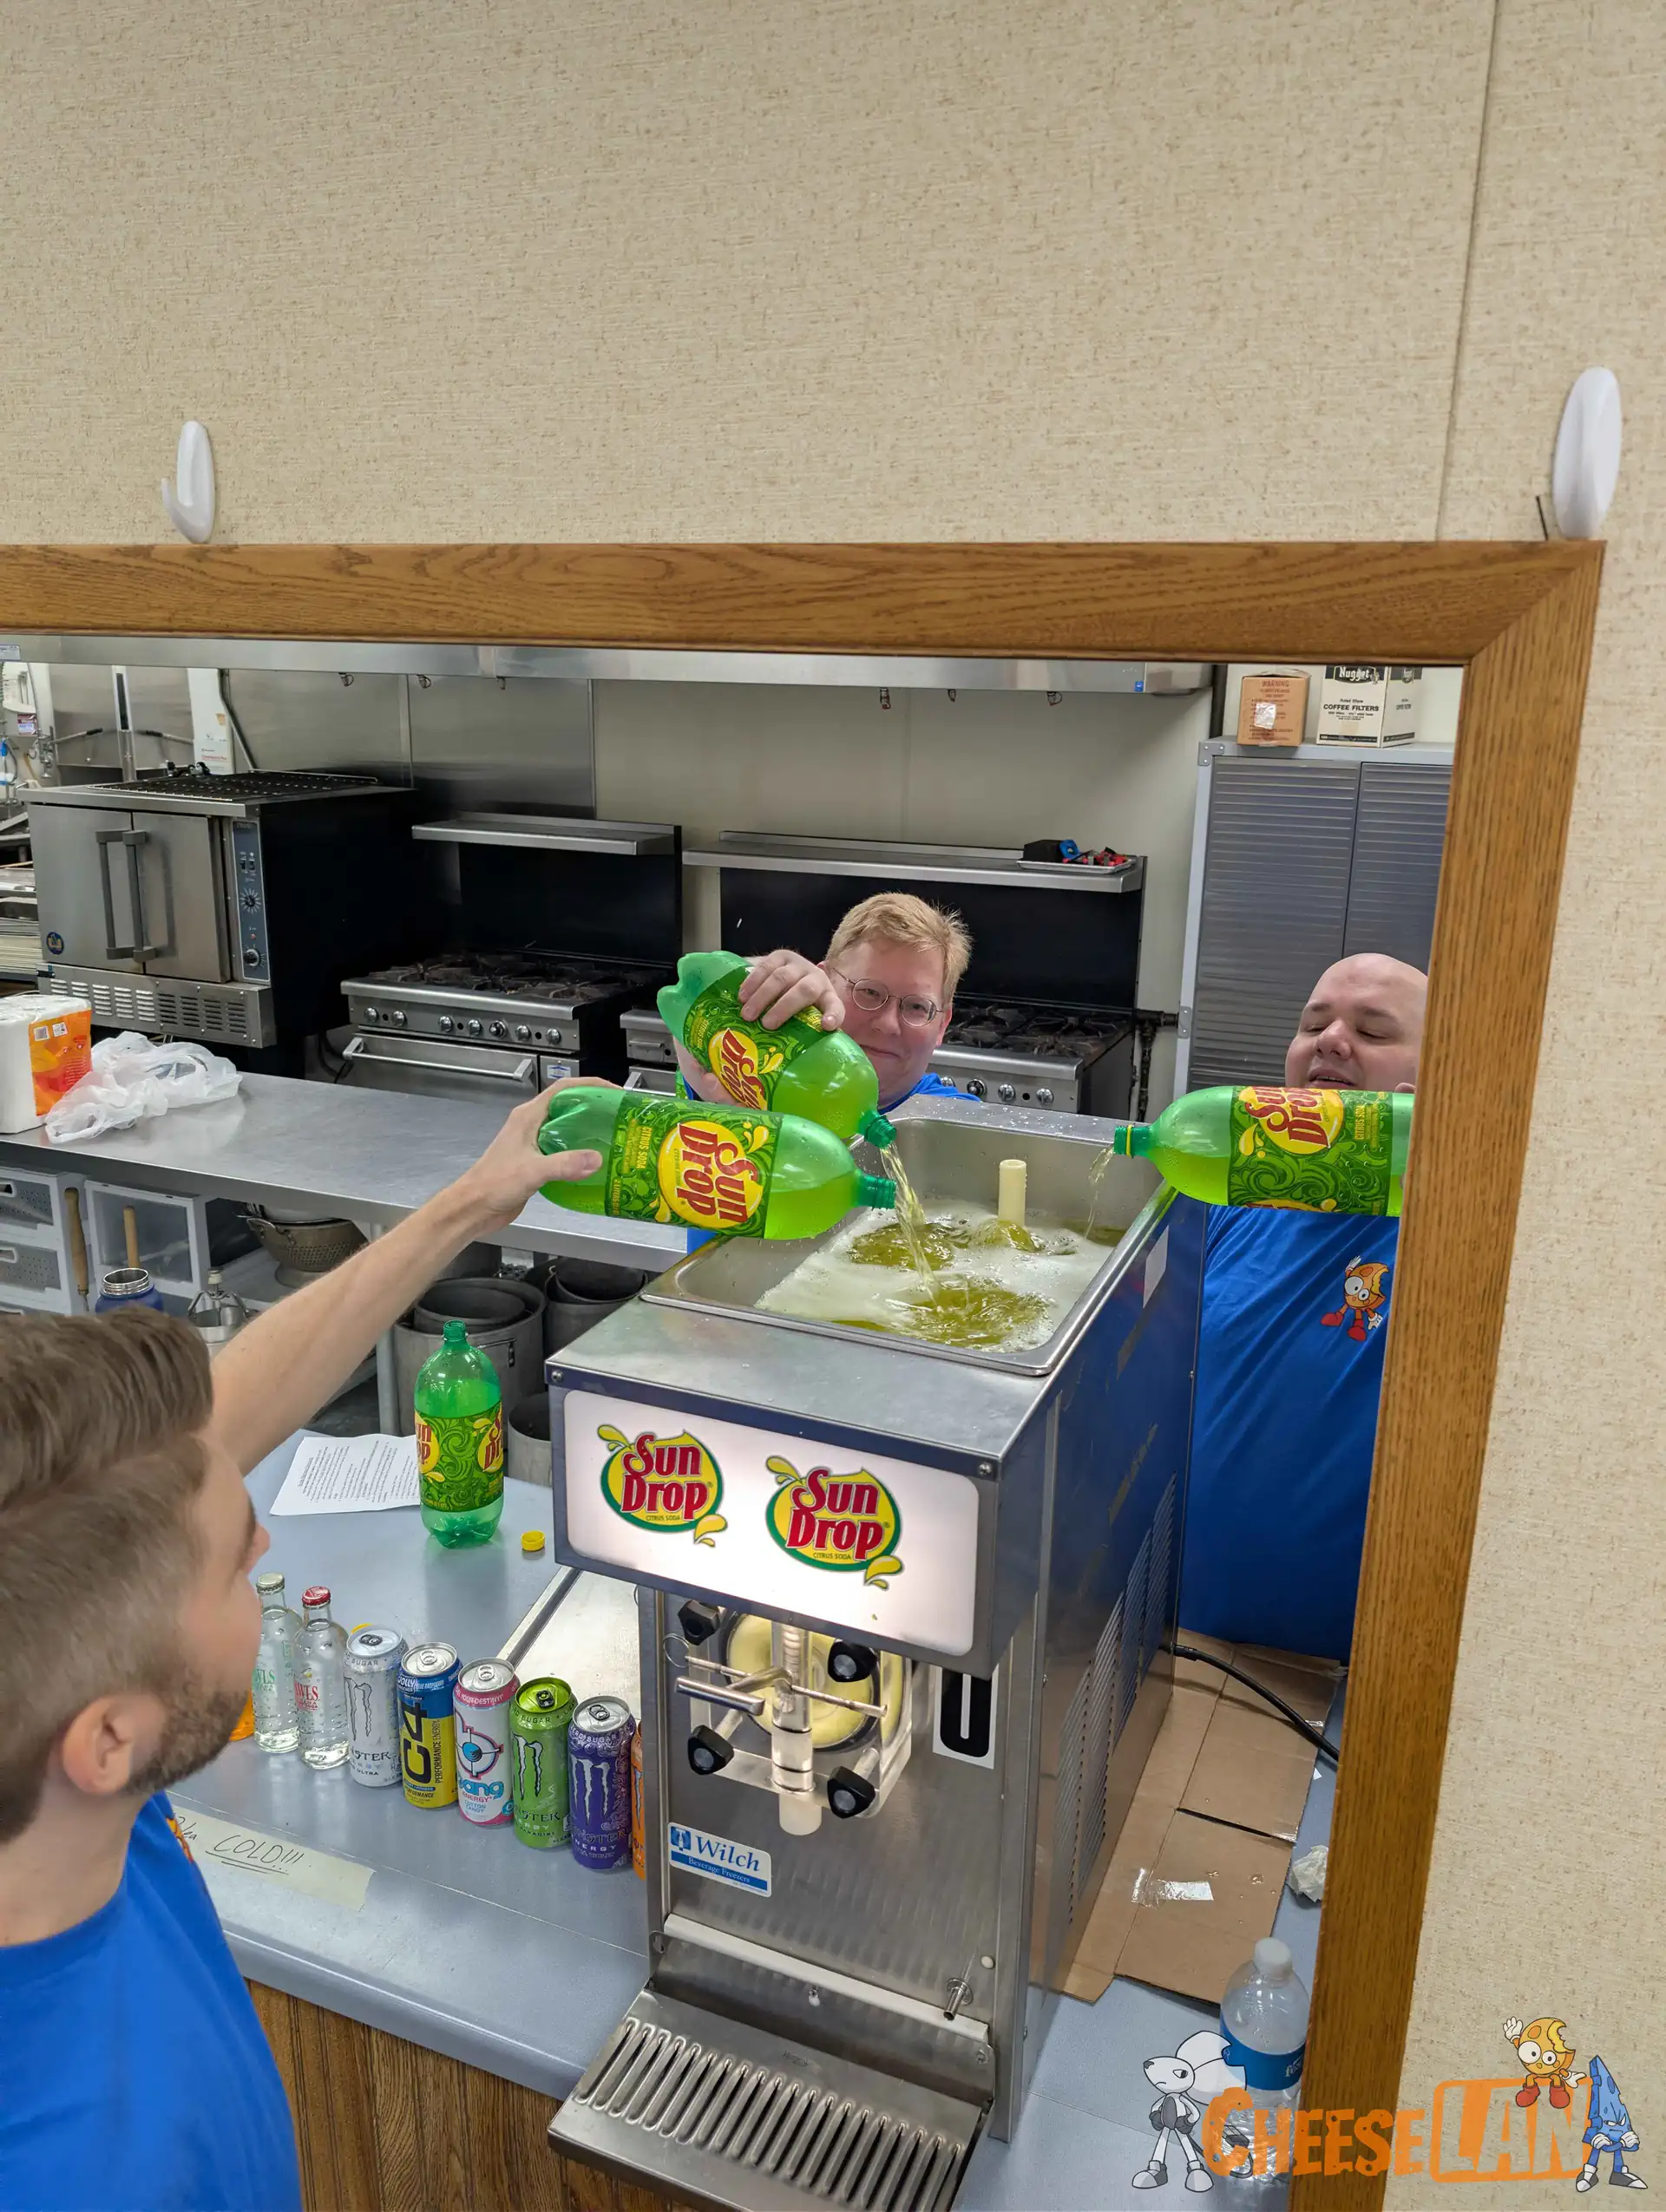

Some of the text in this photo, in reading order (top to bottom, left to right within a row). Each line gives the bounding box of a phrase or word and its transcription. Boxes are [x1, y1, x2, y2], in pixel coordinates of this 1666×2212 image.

[1338, 665, 1370, 681] Nugget
[635, 1127, 653, 1169] CITRUS SODA
[676, 1122, 718, 1216] Drop
[713, 1141, 760, 1224] Sun
[416, 1423, 432, 1443] un
[621, 1432, 702, 1477] Sun
[620, 1474, 710, 1522] Drop
[790, 1467, 879, 1515] Sun
[785, 1507, 885, 1561] Drop
[351, 1658, 379, 1666] SUGAR
[397, 1676, 416, 1688] JOLLY
[521, 1714, 551, 1724] SUGAR
[401, 1702, 432, 1784] C4
[587, 1735, 617, 1744] SUGAR
[351, 1747, 391, 1761] STER
[433, 1738, 443, 1784] PERFORMANCE
[462, 1790, 490, 1803] ENERGY
[466, 1804, 485, 1814] CANDY
[521, 1810, 561, 1823] STER
[213, 1835, 305, 1871] COLD!!!
[574, 1838, 618, 1852] NERGY
[695, 1835, 760, 1872] Wilch
[688, 1856, 751, 1883] Beverage Freezers
